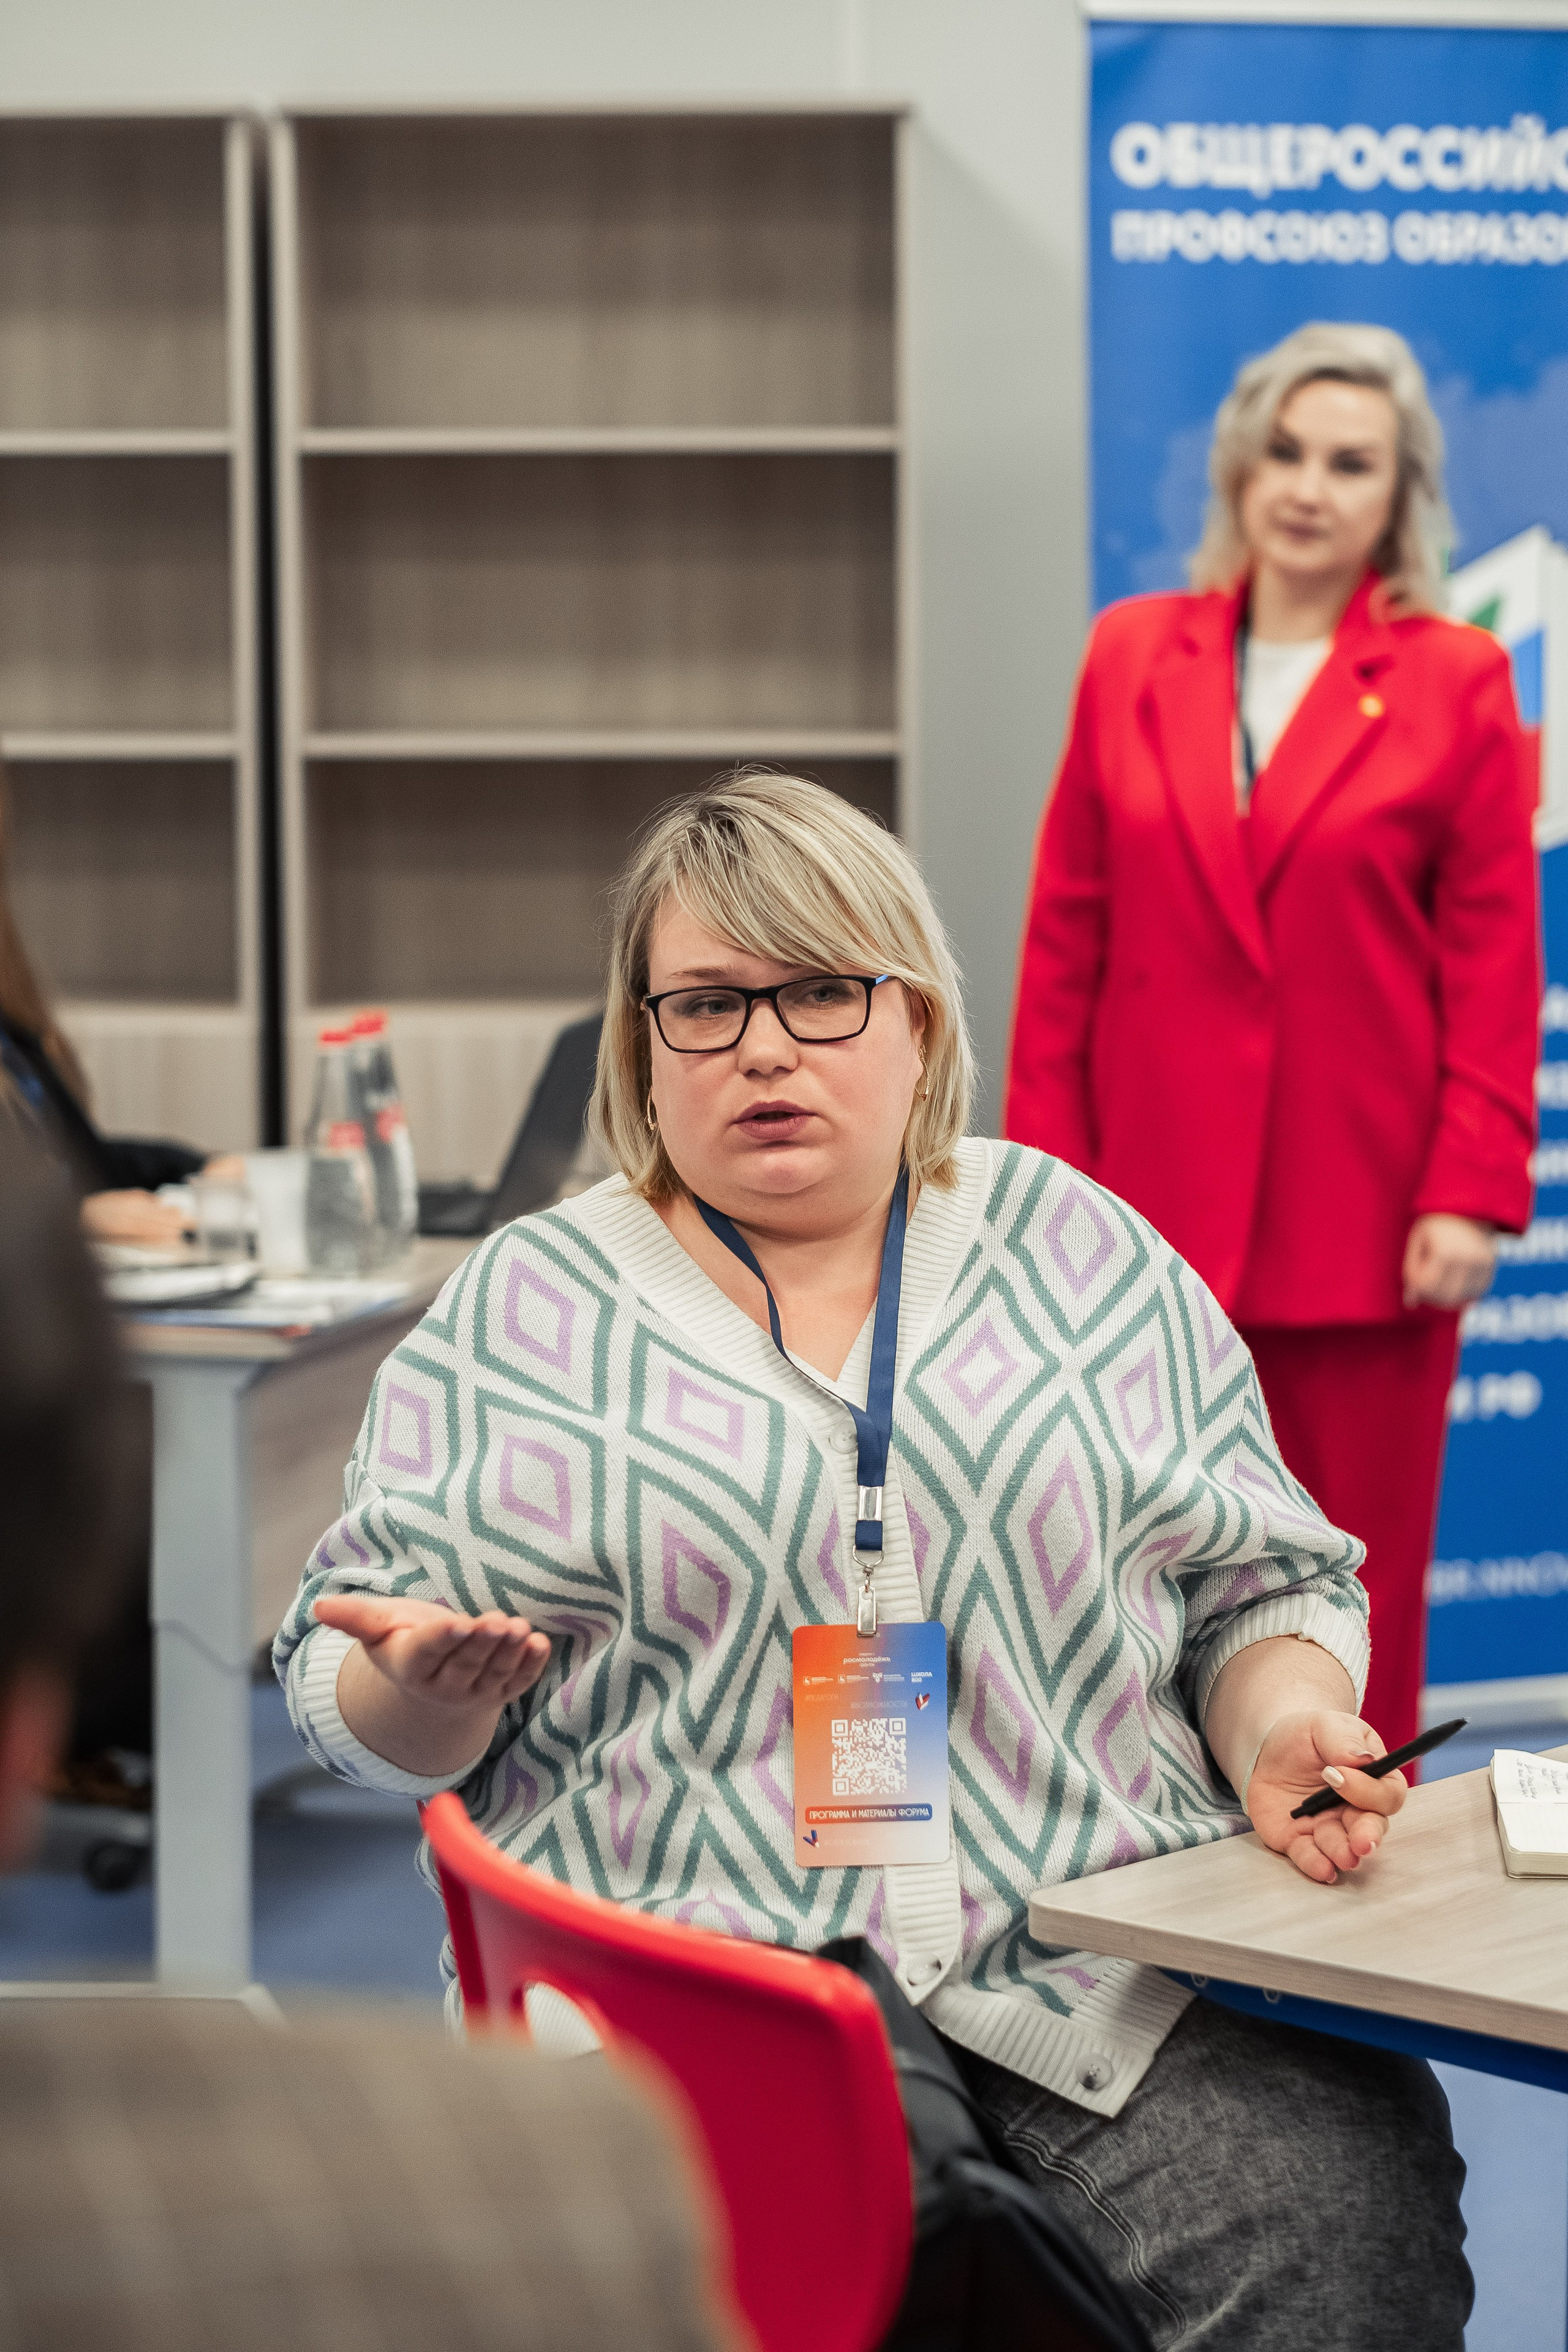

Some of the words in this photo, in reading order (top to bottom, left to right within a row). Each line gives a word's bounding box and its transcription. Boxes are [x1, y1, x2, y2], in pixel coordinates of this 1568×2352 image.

[1111, 210, 1390, 264] ПРОФСОЮЗ
[809, 1809, 850, 1819] ПРОГРАММА
[858, 1808, 897, 1818] МАТЕРИАЛЫ
[898, 1807, 930, 1817] ФОРУМА
